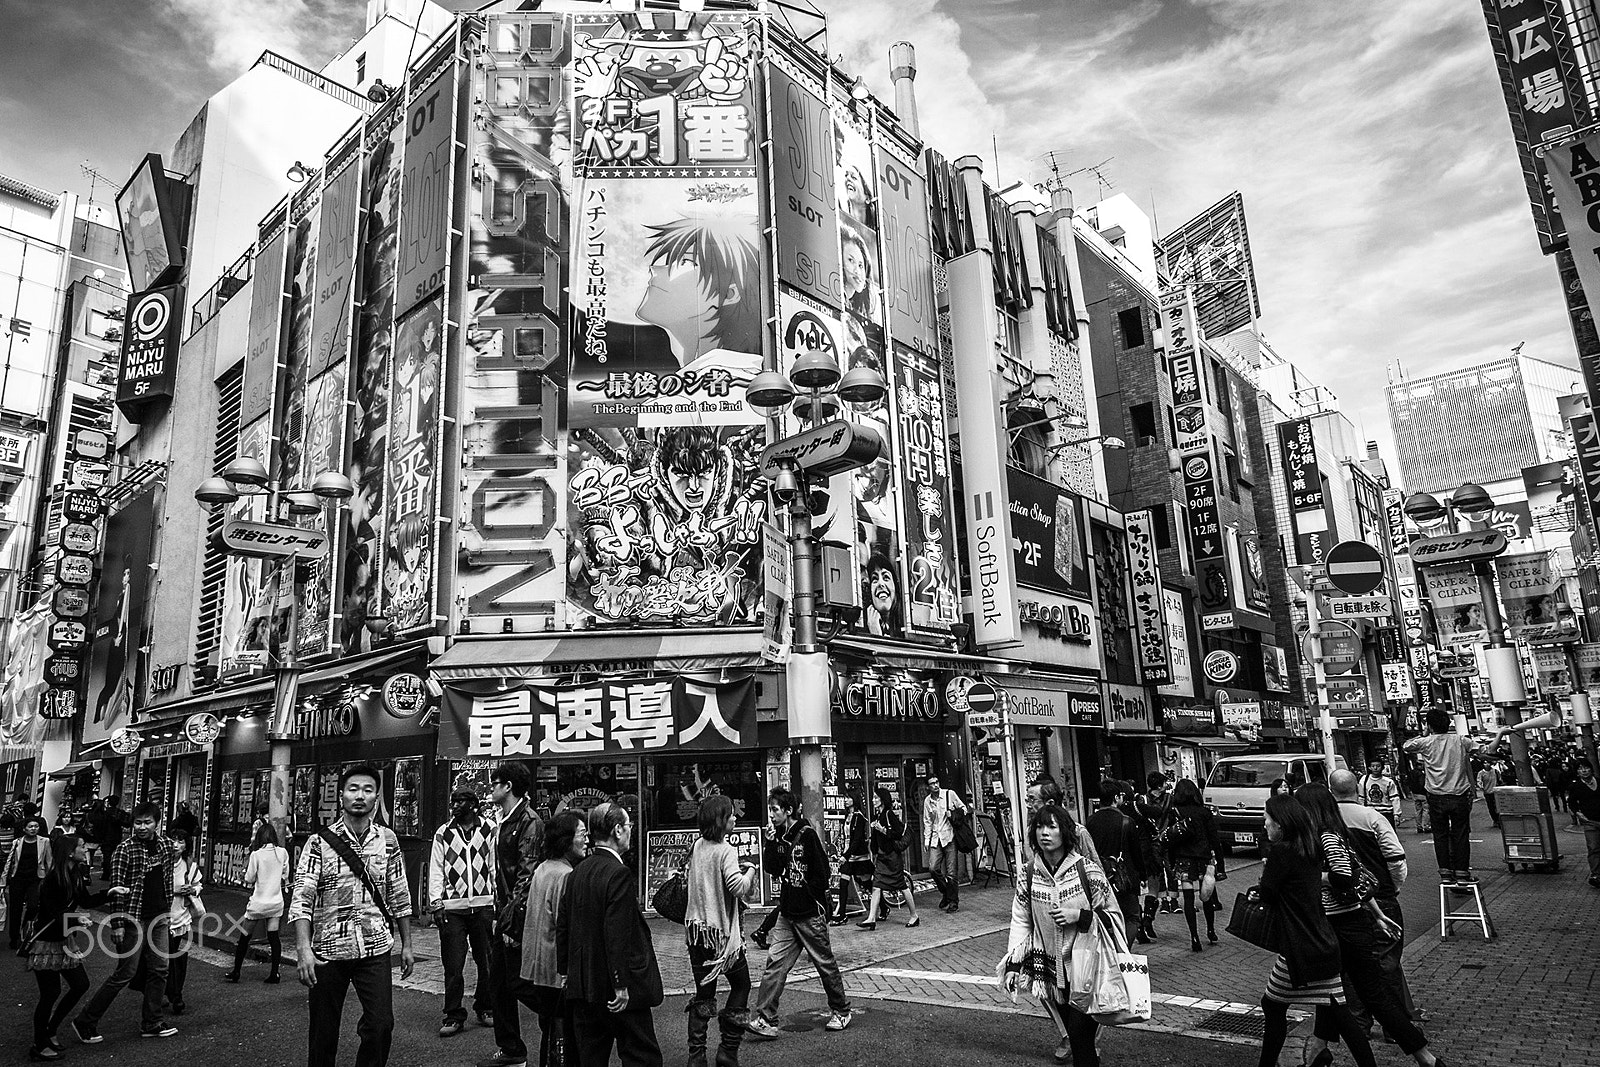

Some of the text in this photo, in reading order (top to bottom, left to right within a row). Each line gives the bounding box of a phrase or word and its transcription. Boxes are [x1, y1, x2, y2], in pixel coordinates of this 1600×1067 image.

[1501, 0, 1567, 114] 広場
[787, 194, 824, 228] SLOT
[415, 267, 445, 301] SLOT
[585, 187, 607, 364] パチンコも最高だね。
[320, 276, 343, 304] SLOT
[788, 287, 834, 319] BB/STATION
[126, 346, 165, 367] NIJYU
[251, 337, 270, 361] SLOT
[1172, 355, 1198, 396] 日焼
[134, 381, 150, 396] 5F
[675, 401, 697, 412] and
[699, 401, 717, 412] the
[719, 400, 743, 412] End
[1297, 423, 1315, 465] お好み焼
[1287, 440, 1307, 491] もんじゃ焼
[1193, 485, 1207, 497] 2F
[69, 503, 97, 514] MARU
[70, 496, 98, 508] NIJYU
[1189, 496, 1214, 510] 90席
[1030, 503, 1053, 528] Shop
[1197, 512, 1211, 523] 1F
[228, 528, 324, 550] 渋谷センター街
[1193, 523, 1218, 536] 12席
[1023, 540, 1042, 567] 2F
[976, 525, 1004, 628] SoftBank
[1429, 576, 1468, 589] SAFE &
[1500, 567, 1541, 580] SAFE &
[1509, 576, 1551, 590] CLEAN
[1437, 586, 1478, 599] CLEAN
[1018, 600, 1091, 635] AHOO! BB
[1333, 600, 1388, 615] 自転車を除く
[1204, 615, 1233, 627] センタービル
[1207, 655, 1230, 669] BURGER
[1209, 661, 1232, 677] KING
[151, 664, 178, 693] SLOT
[1011, 695, 1056, 718] SoftBank
[467, 681, 741, 757] 最速導入
[969, 715, 998, 725] 自転車を除く
